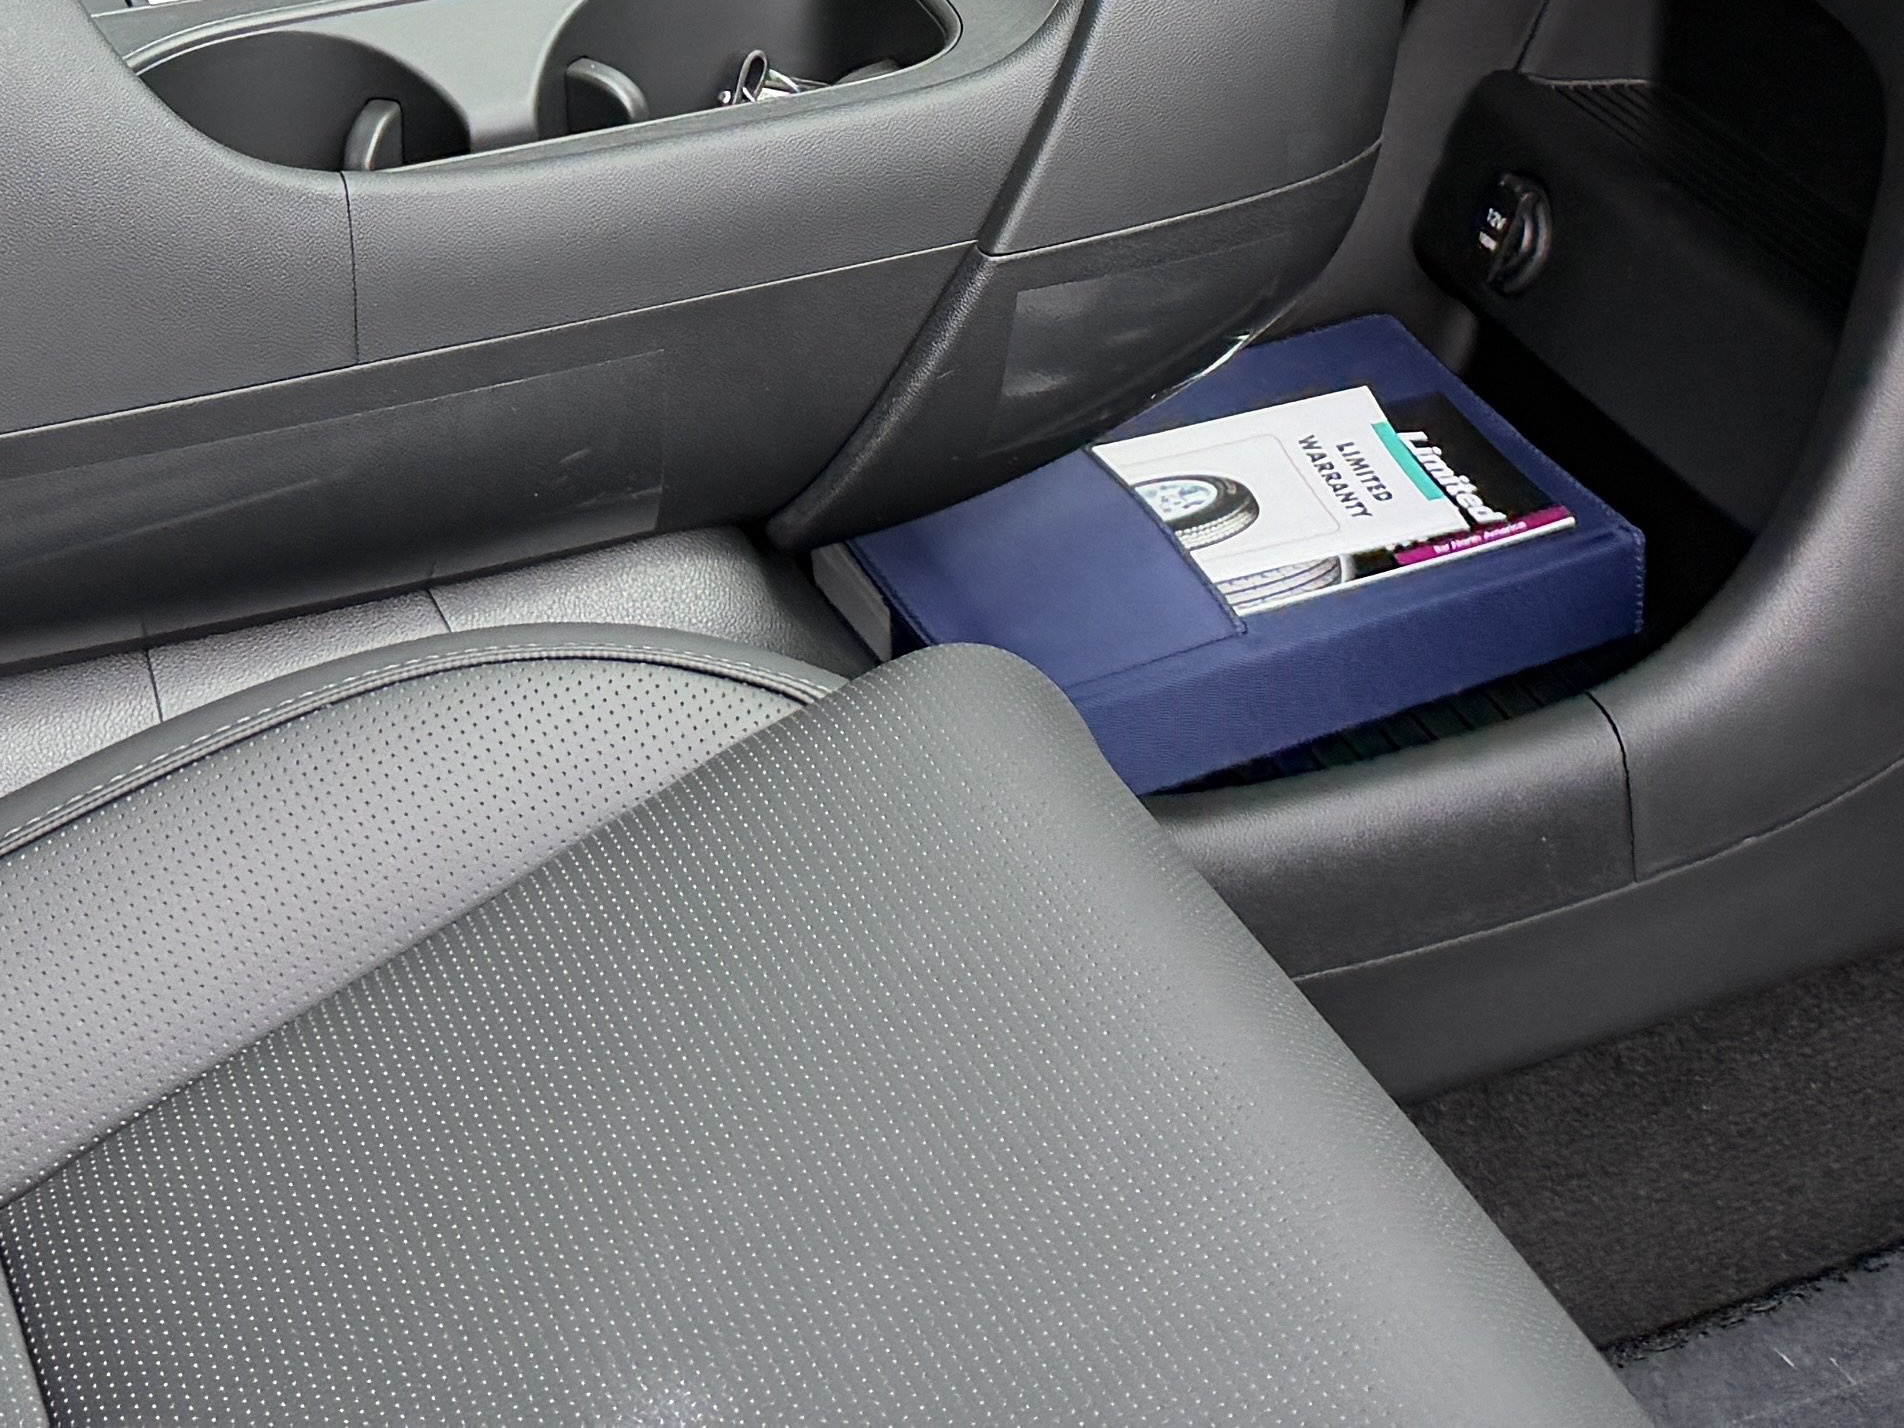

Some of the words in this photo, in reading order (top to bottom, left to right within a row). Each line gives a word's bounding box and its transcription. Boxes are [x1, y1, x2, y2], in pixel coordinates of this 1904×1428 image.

[1298, 433, 1374, 520] WARRANTY
[1336, 441, 1394, 502] LIMITED
[1396, 430, 1508, 525] Limited
